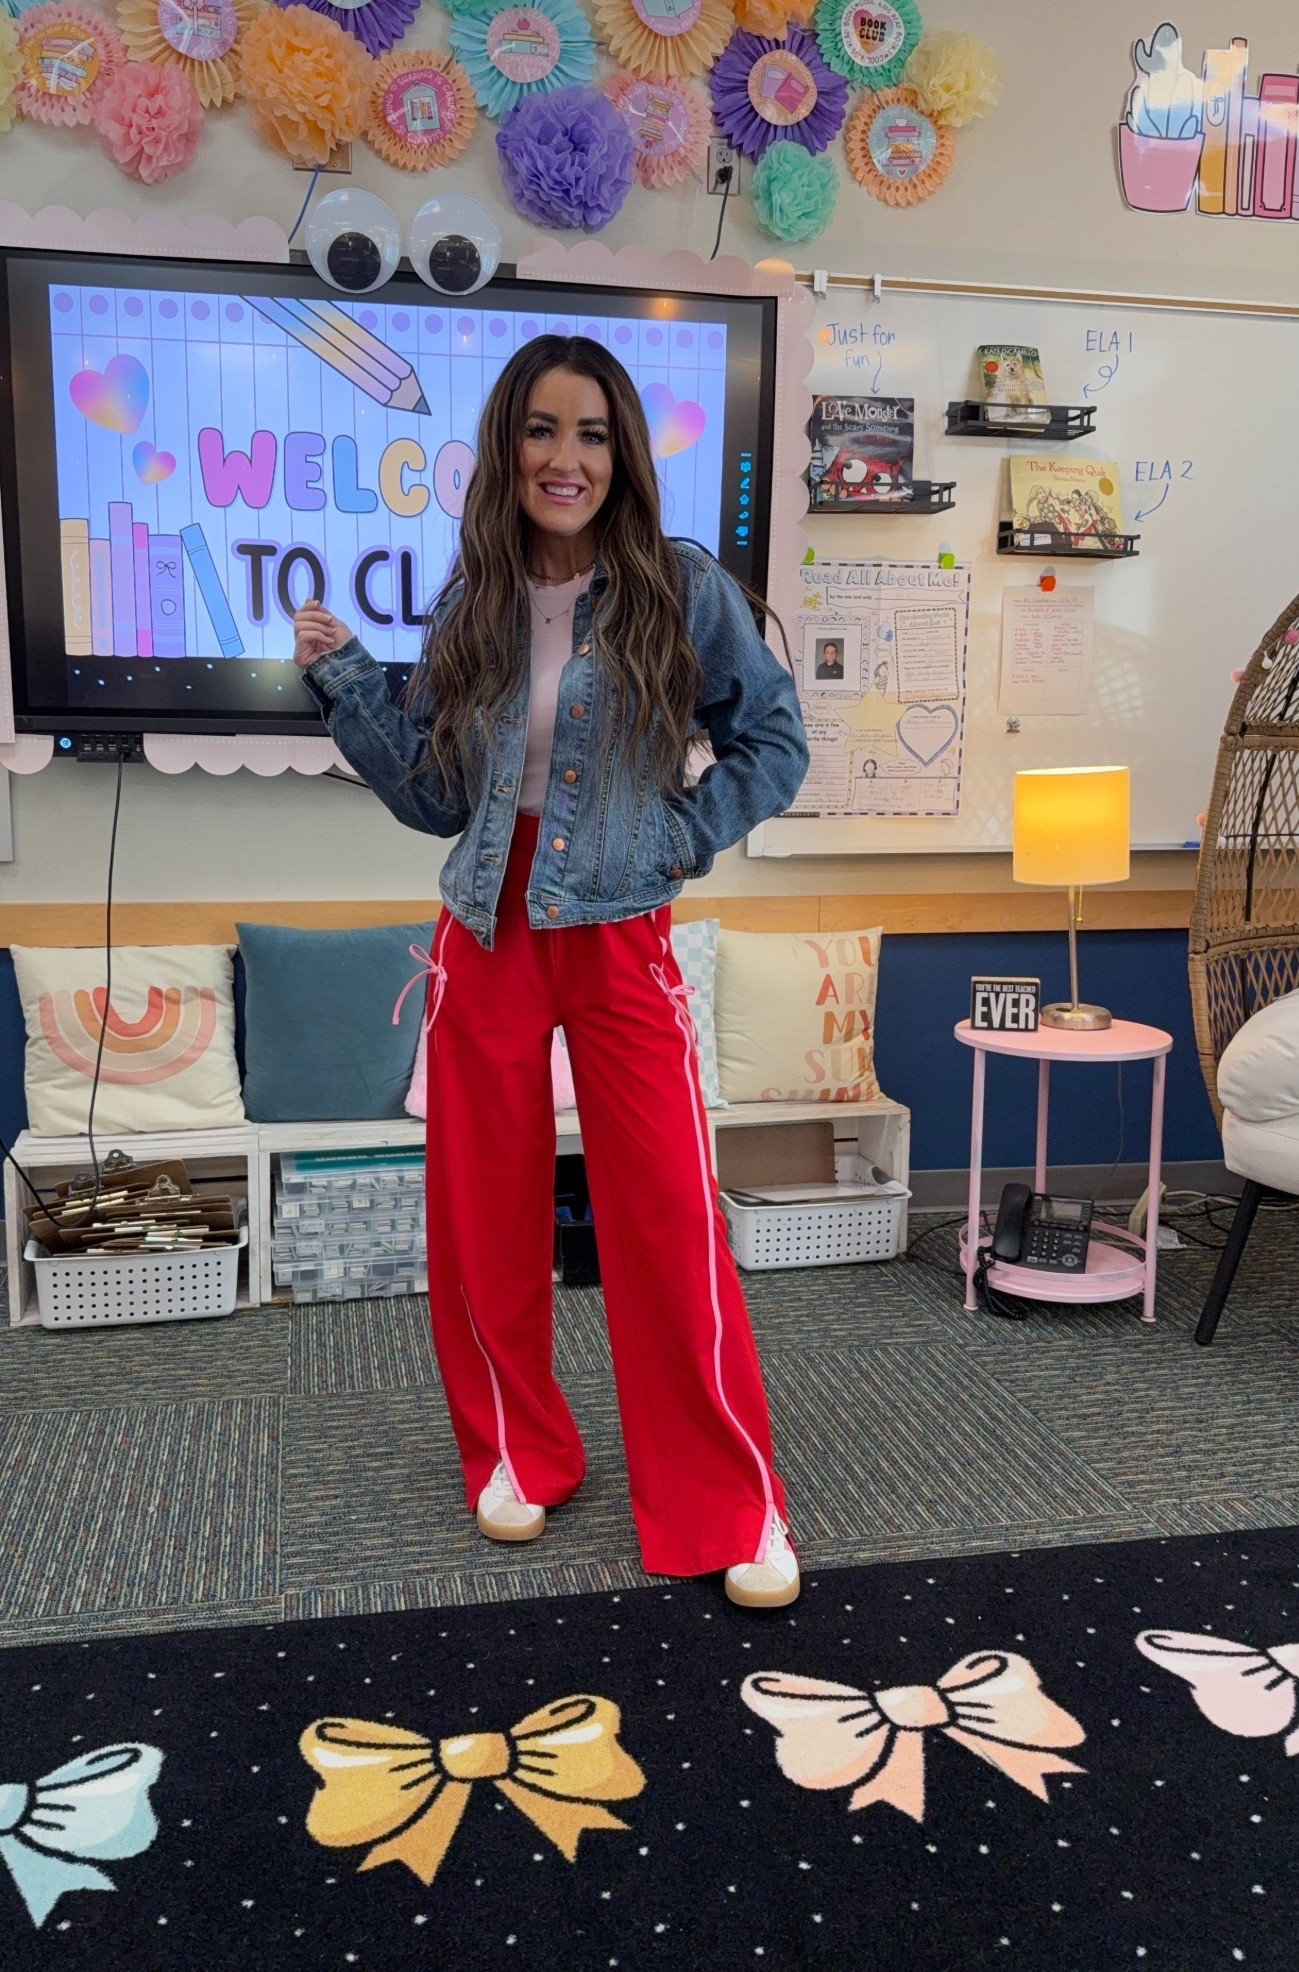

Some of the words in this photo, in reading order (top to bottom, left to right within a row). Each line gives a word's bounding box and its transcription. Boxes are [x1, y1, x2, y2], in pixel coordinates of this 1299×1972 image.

[878, 2, 892, 14] KIDS
[860, 17, 886, 31] BOOK
[860, 28, 885, 42] CLUB
[397, 71, 432, 86] SHARING
[442, 85, 456, 120] CARING
[826, 322, 868, 346] Just
[872, 324, 896, 346] for
[1086, 330, 1120, 352] ELA
[845, 348, 870, 368] fun
[854, 404, 900, 422] Monster
[844, 424, 864, 432] Scary
[866, 424, 900, 433] Something
[1027, 460, 1046, 472] The
[1048, 462, 1084, 476] Keeping
[1135, 460, 1172, 482] ELA
[1180, 460, 1194, 480] 2
[236, 544, 326, 622] TO
[354, 550, 462, 626] CL
[800, 568, 842, 585] Read
[846, 570, 870, 586] All
[875, 571, 926, 587] About
[928, 572, 960, 588] Me!
[804, 936, 880, 968] YOU
[976, 984, 992, 992] YOU'RE
[993, 984, 1001, 992] THE
[1002, 985, 1014, 993] BEST
[975, 992, 1036, 1030] EVER
